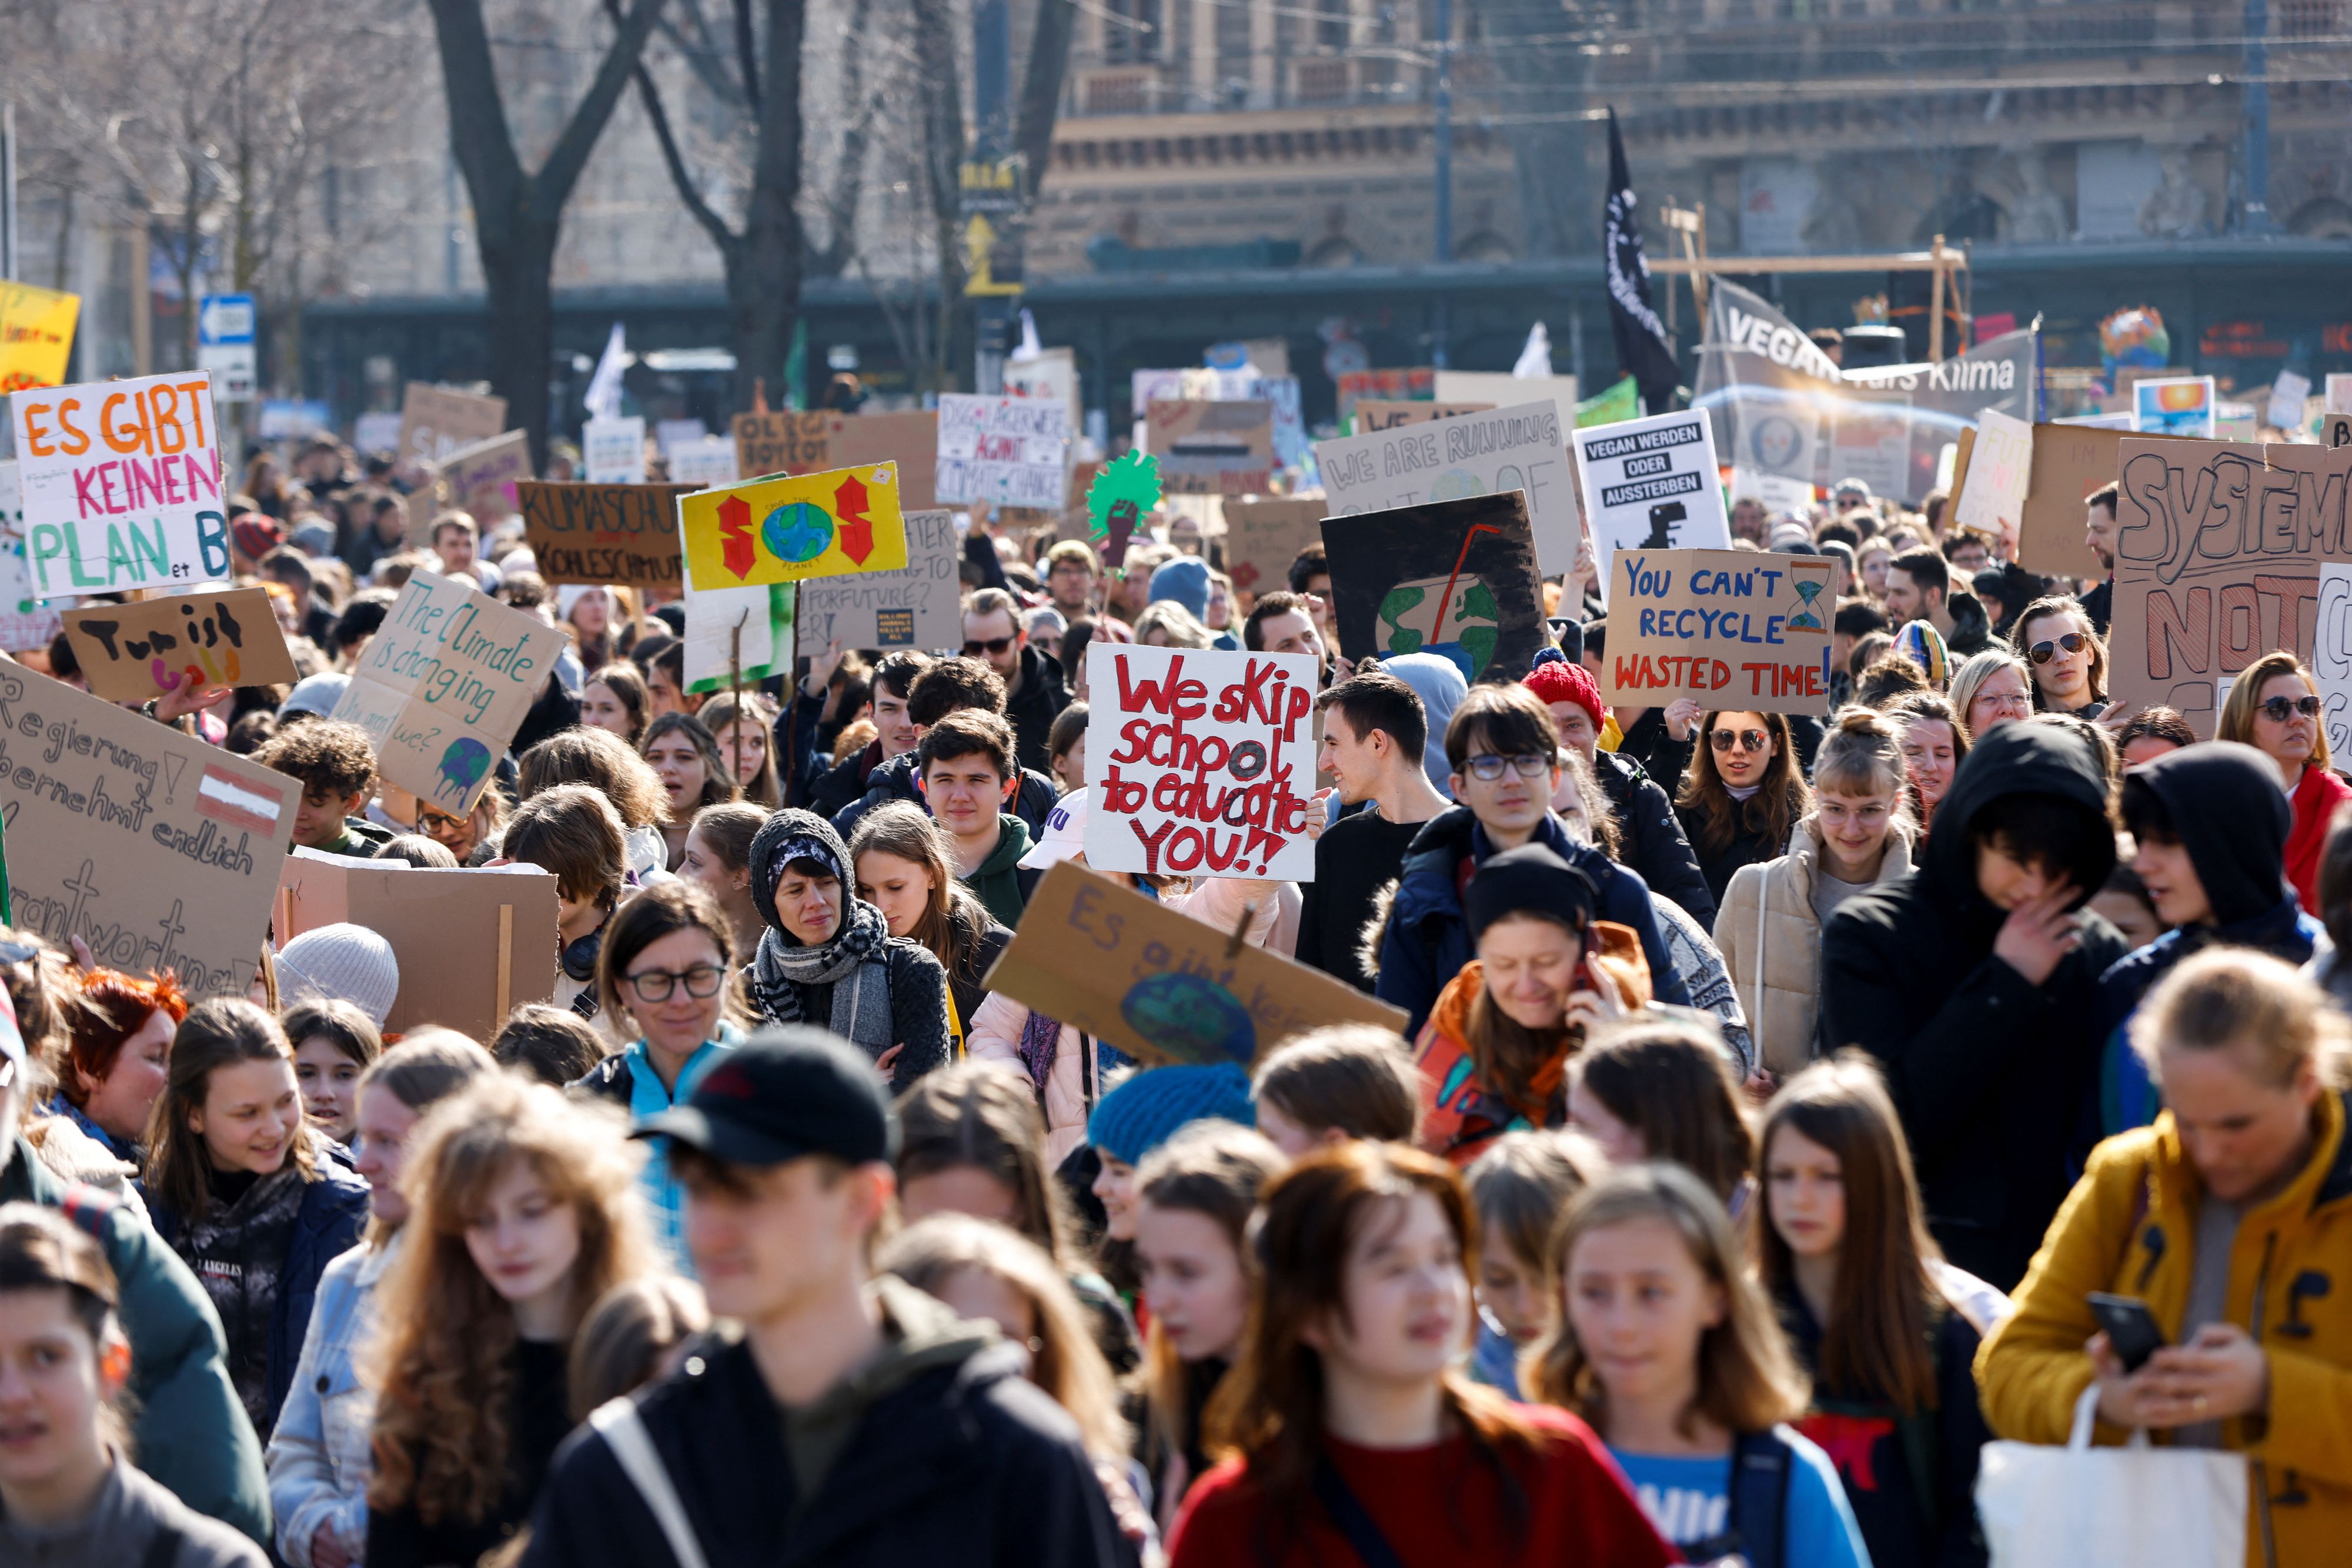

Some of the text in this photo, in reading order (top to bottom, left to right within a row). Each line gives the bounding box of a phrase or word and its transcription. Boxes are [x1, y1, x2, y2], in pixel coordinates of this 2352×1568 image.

[25, 380, 209, 457] ES GIBT
[1588, 424, 1698, 459] VEGAN WERDEN
[73, 447, 223, 520] KEINEN
[1327, 413, 1558, 492] WE ARE RUNNING
[1627, 455, 1666, 477] ODER
[765, 500, 786, 513] SAVE
[1605, 474, 1698, 506] AUSSTERBEN
[2119, 452, 2344, 584] SYSTEM
[31, 516, 170, 593] PLAN
[195, 510, 229, 577] B
[781, 556, 821, 571] PLANET
[925, 553, 952, 580] TO
[1625, 556, 1783, 599] YOU CAN'T
[396, 580, 533, 683] The Climate
[1639, 606, 1786, 644] RECYCLE
[2147, 574, 2320, 680] NOT
[372, 637, 496, 725] is changing
[1114, 654, 1207, 720] We
[1615, 644, 1830, 698] WASTED TIME!
[392, 723, 442, 753] we?
[1110, 718, 1293, 783] school
[0, 739, 253, 875] bernehmt endlich
[1101, 765, 1307, 835] to educate
[1131, 818, 1289, 876] YOU!!
